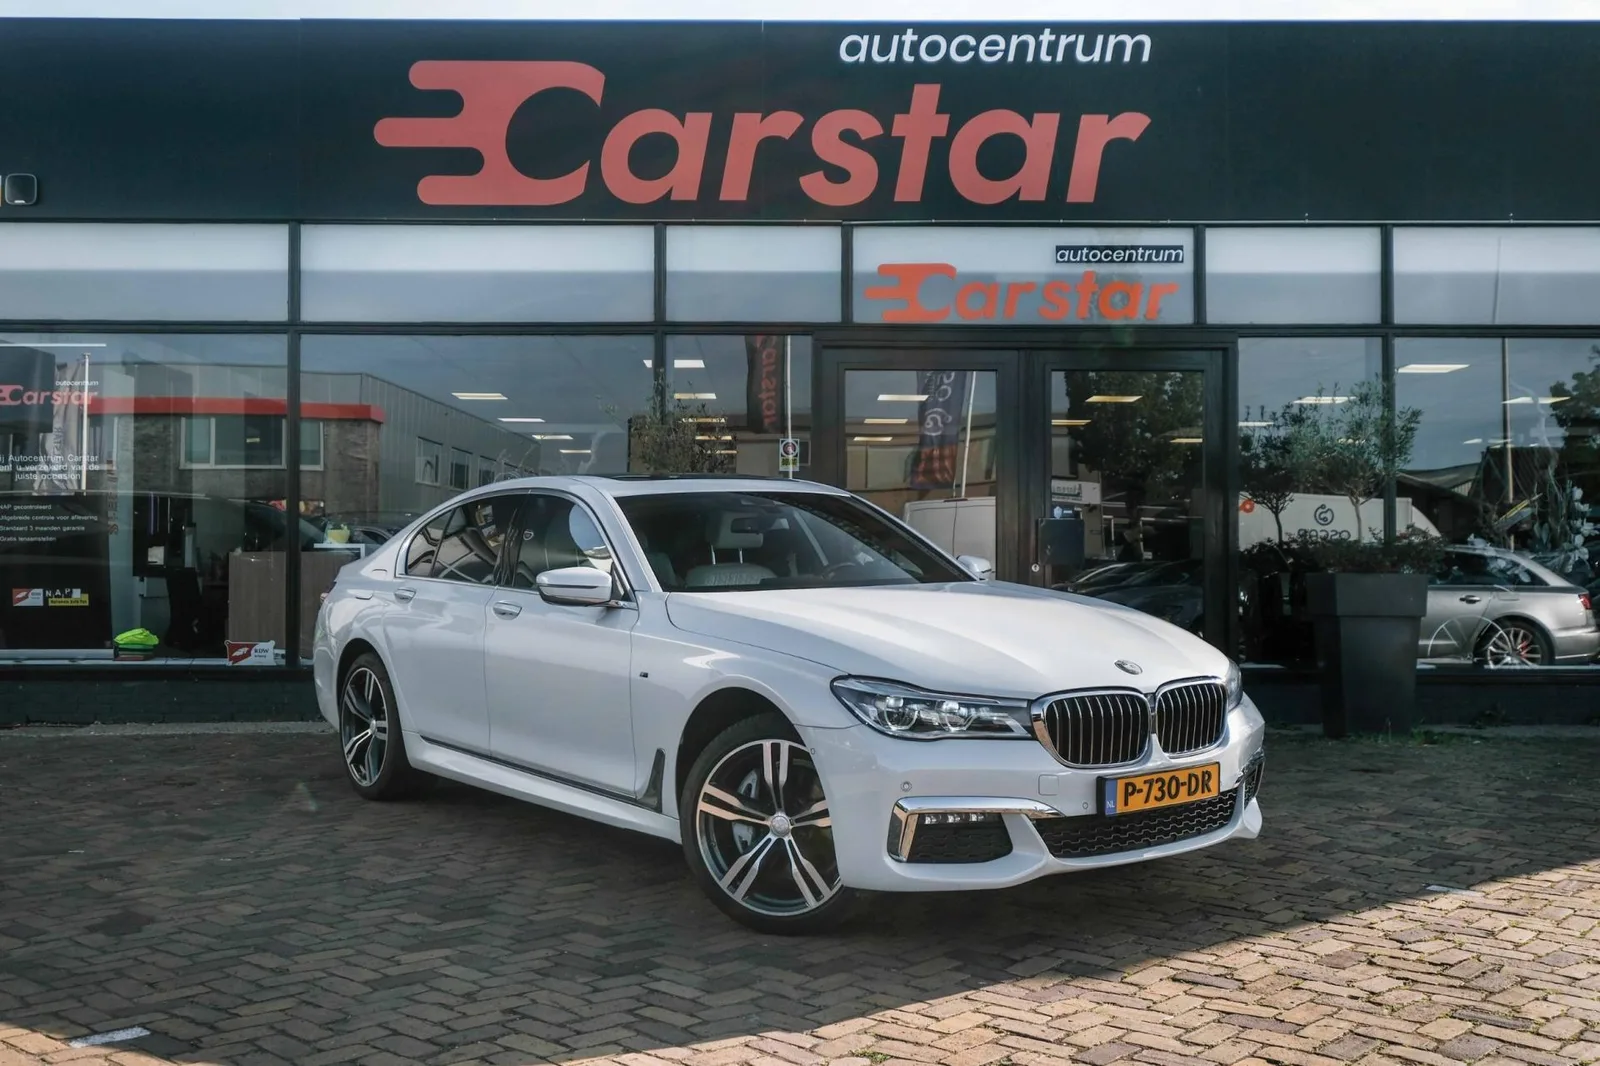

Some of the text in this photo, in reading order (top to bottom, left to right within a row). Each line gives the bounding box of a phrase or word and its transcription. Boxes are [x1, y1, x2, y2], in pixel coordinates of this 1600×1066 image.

[838, 27, 1152, 63] autocentrum
[374, 60, 1152, 207] Carstar
[1056, 246, 1184, 263] autocentrum
[863, 263, 1180, 323] Carstar
[0, 384, 98, 406] Carstar
[9, 454, 64, 462] Autocentrum
[67, 454, 99, 462] Carstar
[88, 463, 100, 471] de
[15, 472, 38, 481] juiste
[1123, 770, 1213, 807] P-730-DR
